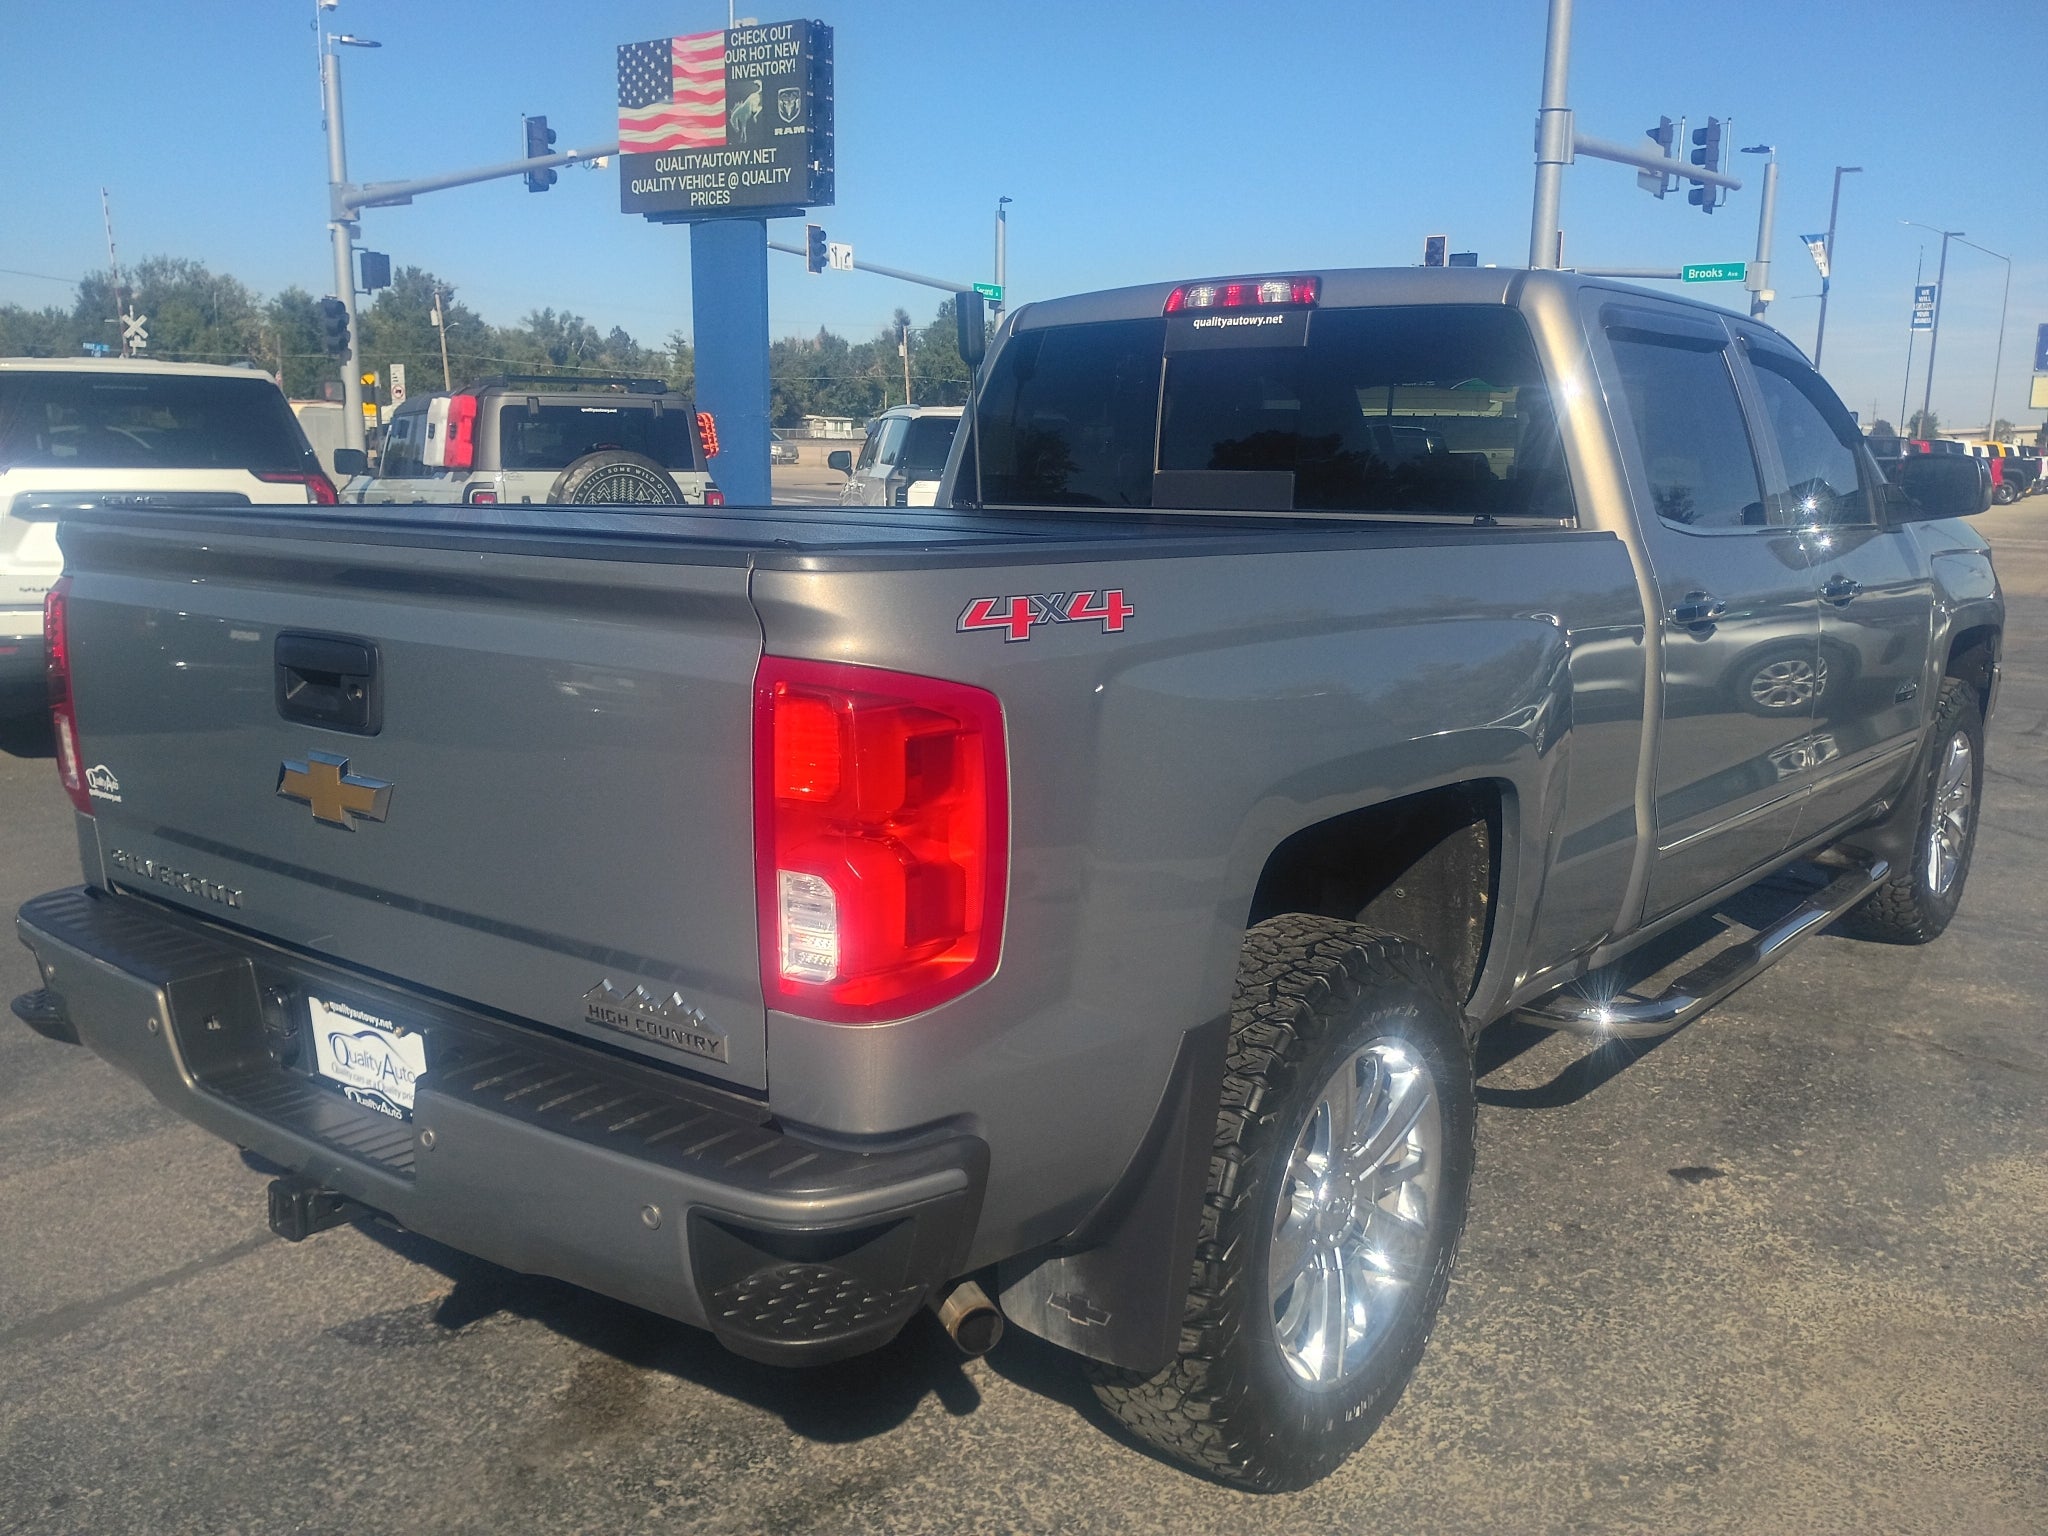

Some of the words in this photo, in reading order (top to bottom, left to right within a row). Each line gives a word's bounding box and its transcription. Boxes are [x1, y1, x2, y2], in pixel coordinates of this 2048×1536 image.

[731, 28, 768, 46] CHECK
[770, 25, 793, 41] OUT
[725, 48, 747, 64] OUR
[749, 44, 772, 61] HOT
[774, 40, 800, 58] NEW
[731, 58, 796, 80] INVENTORY!
[774, 125, 806, 136] RAM
[655, 148, 777, 173] QUALITYAUTOWY.NET
[631, 176, 677, 194] QUALITY
[678, 173, 725, 190] VEHICLE
[727, 172, 739, 190] @
[741, 168, 792, 186] QUALITY
[690, 190, 731, 207] PRICES
[1688, 267, 1723, 279] Brooks
[1193, 314, 1284, 330] qualityautowy.net
[583, 472, 604, 489] STILL
[607, 466, 631, 474] SOME
[635, 469, 655, 482] WILD
[657, 483, 670, 499] OUT
[329, 1001, 394, 1030] qualityautowy.net
[588, 1003, 629, 1027] HIGH
[635, 1018, 720, 1054] COUNTRY
